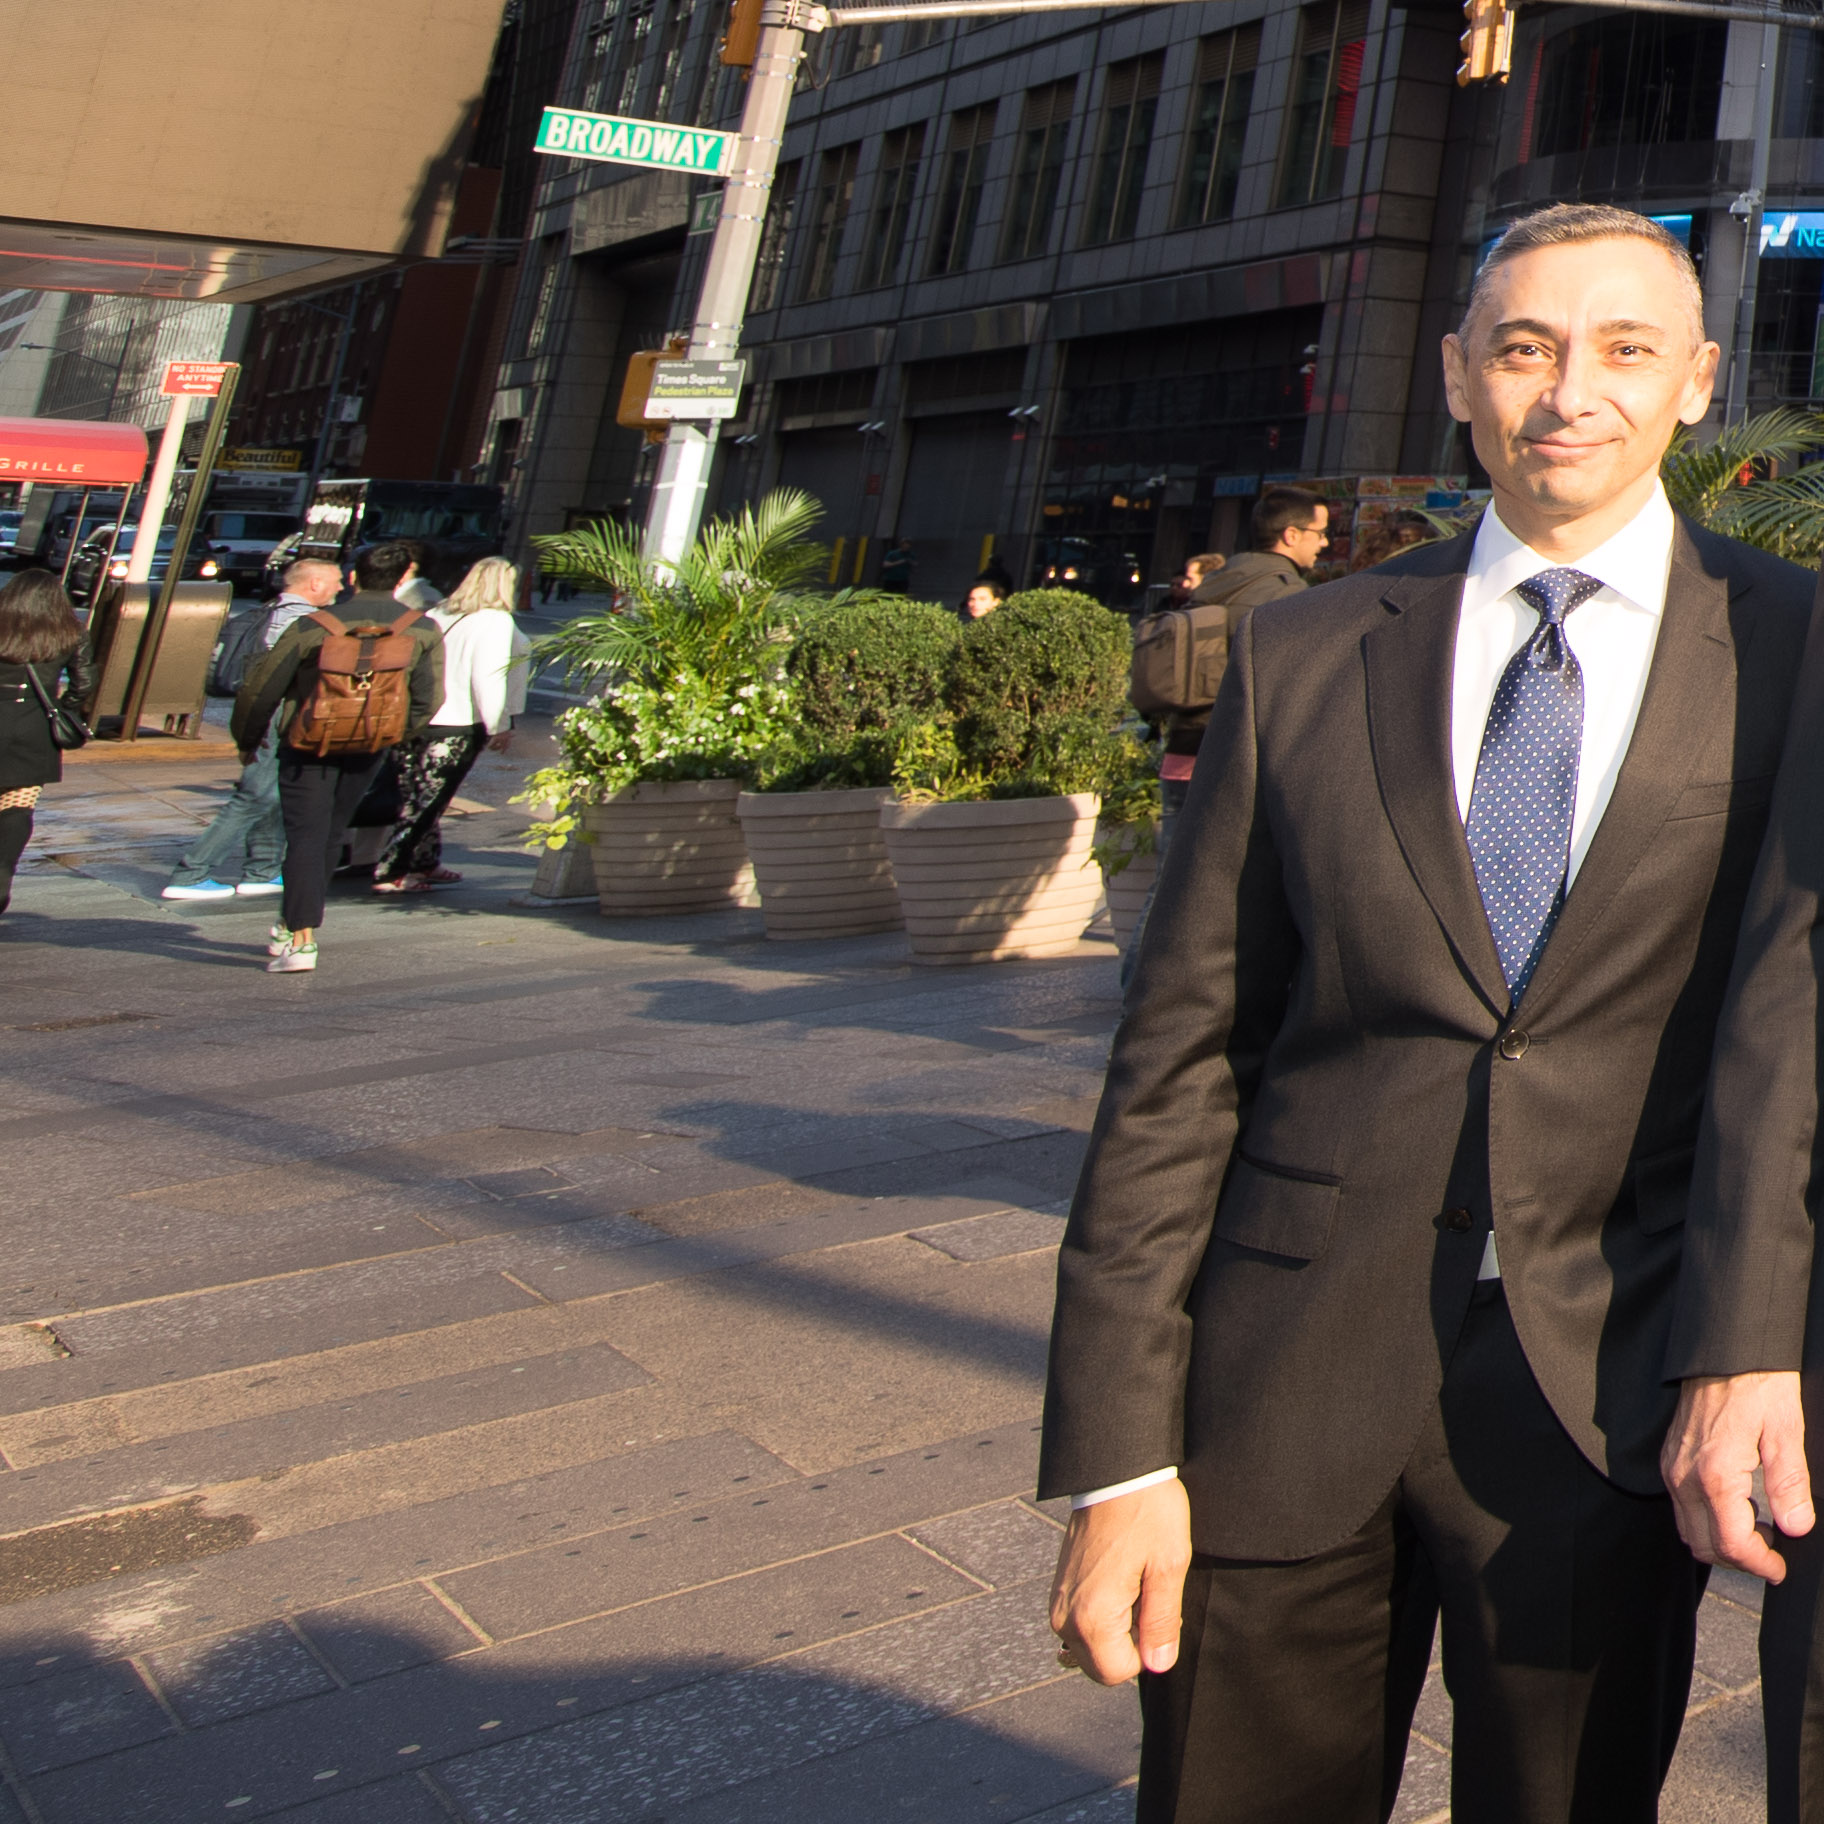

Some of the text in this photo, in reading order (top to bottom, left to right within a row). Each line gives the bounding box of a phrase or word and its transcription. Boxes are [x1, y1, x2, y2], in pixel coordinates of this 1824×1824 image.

[545, 114, 717, 167] BROADWAY
[171, 364, 186, 373] NO
[656, 373, 727, 386] Times Square
[653, 385, 735, 396] Pedestrian Plaza
[225, 448, 298, 464] Beautiful
